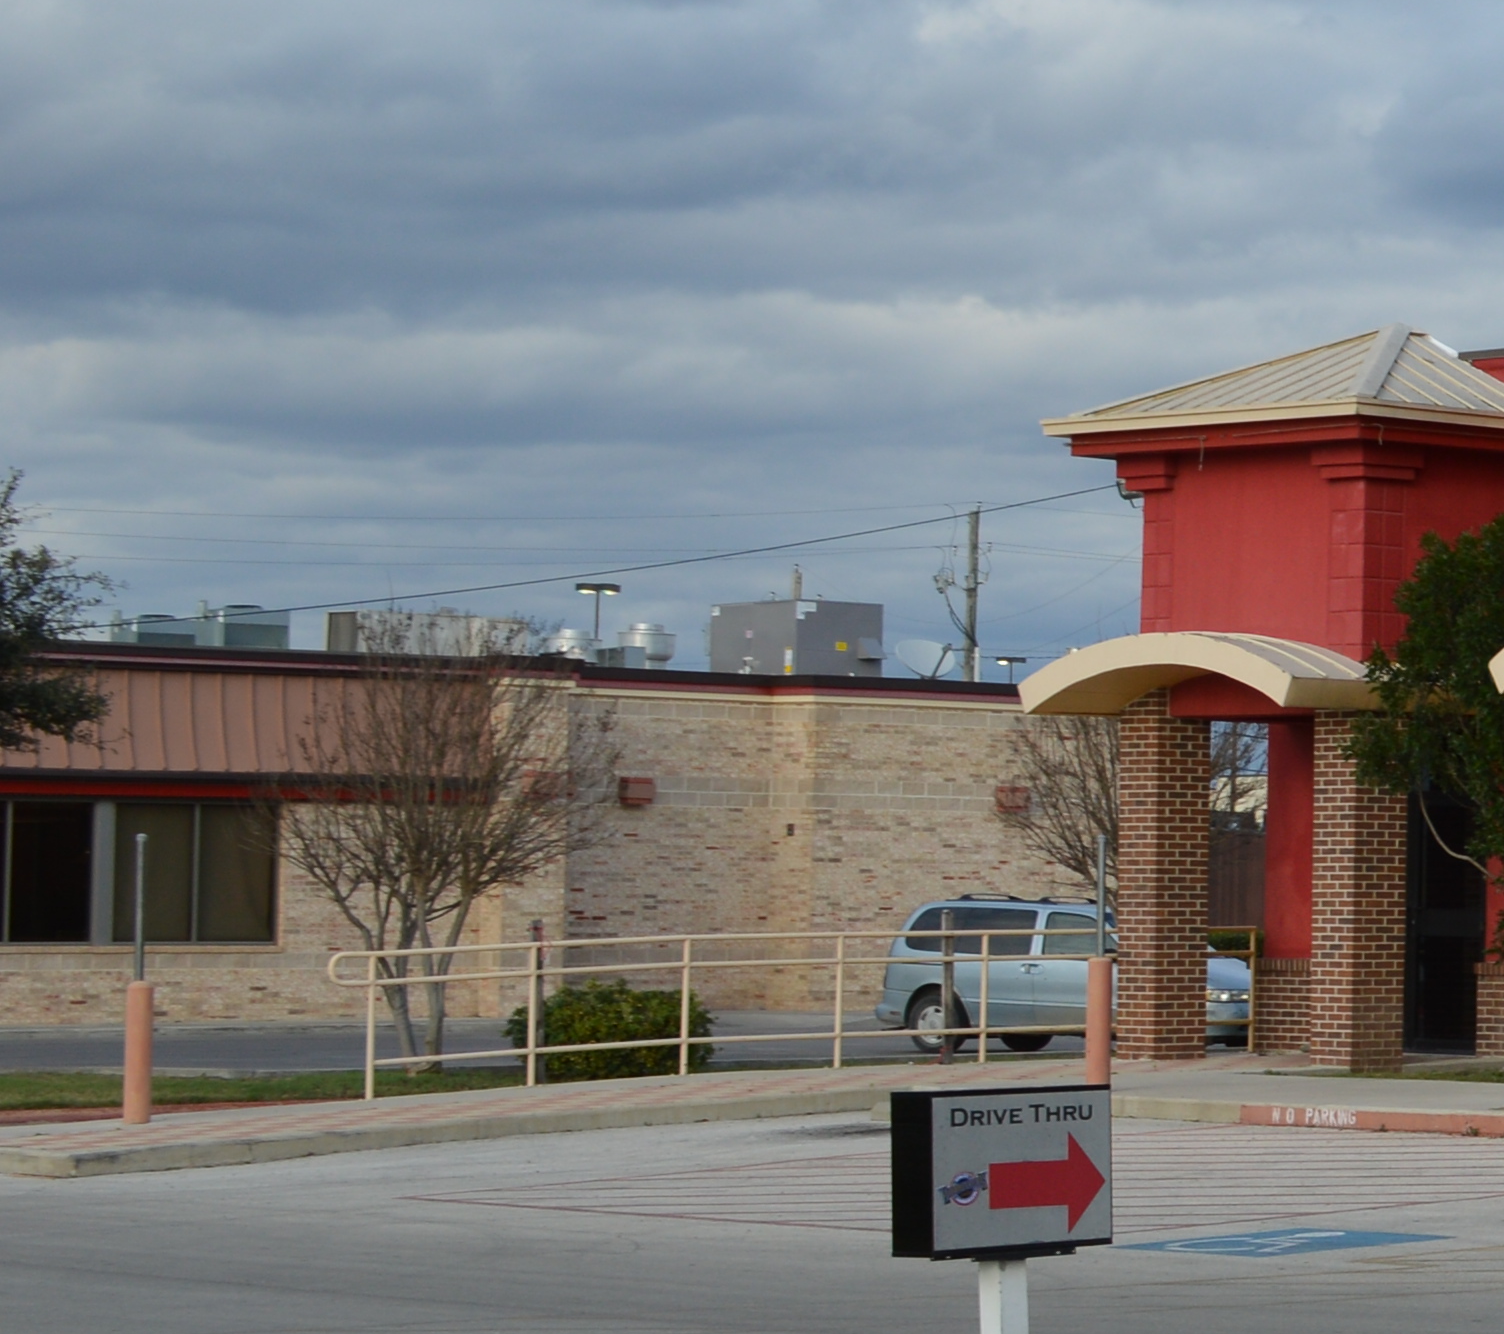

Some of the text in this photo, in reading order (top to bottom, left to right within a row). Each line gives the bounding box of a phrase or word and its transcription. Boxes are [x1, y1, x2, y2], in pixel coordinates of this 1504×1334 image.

[950, 1104, 1093, 1127] DRIVE THRU
[1271, 1107, 1357, 1126] NO PARKING
